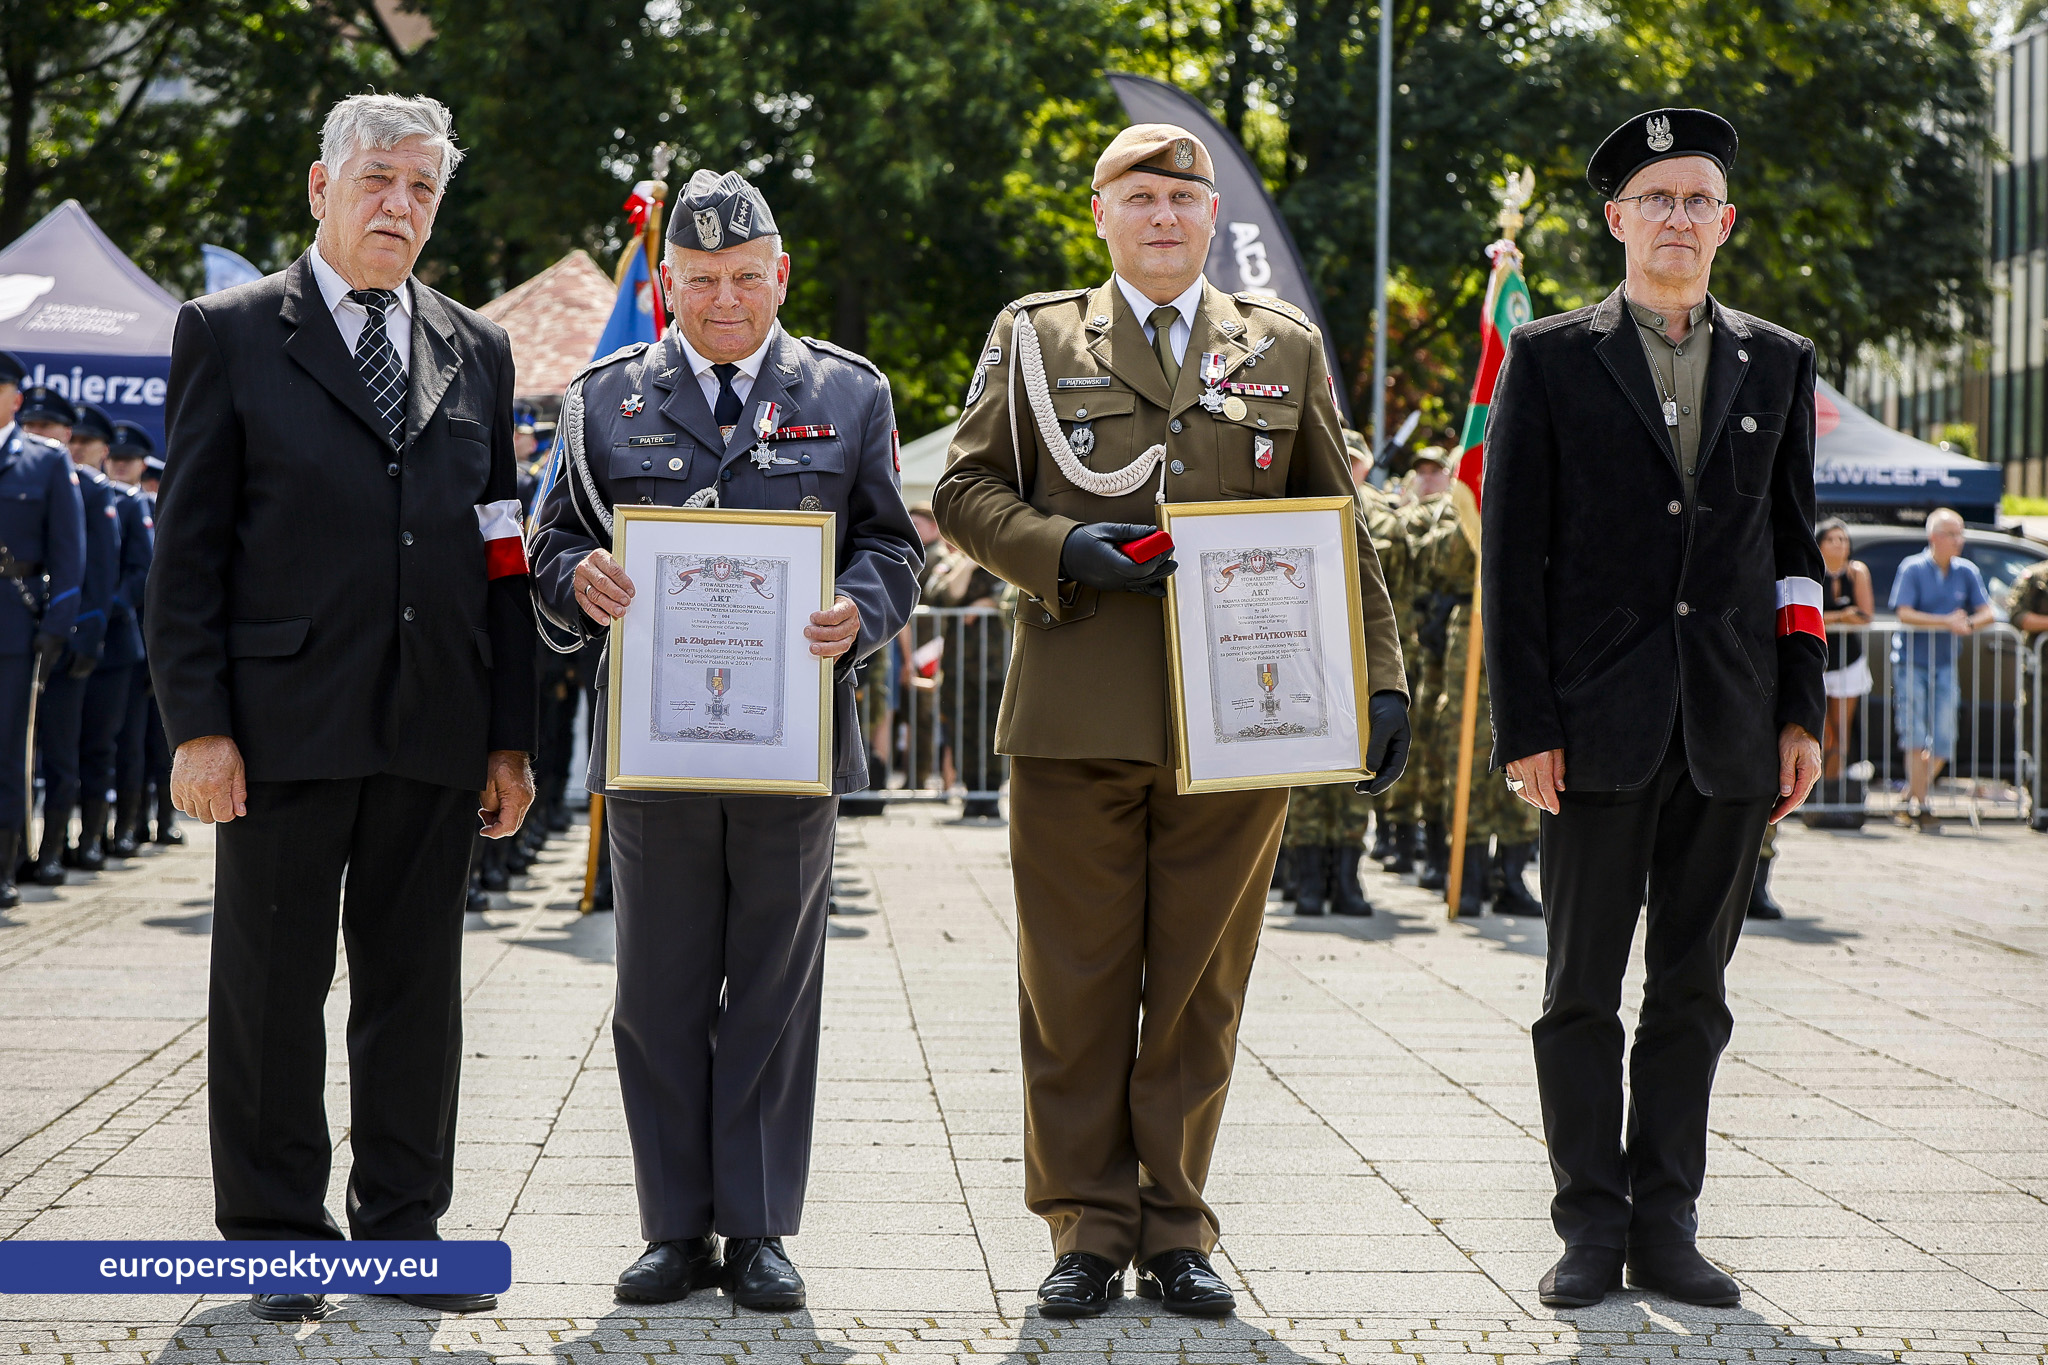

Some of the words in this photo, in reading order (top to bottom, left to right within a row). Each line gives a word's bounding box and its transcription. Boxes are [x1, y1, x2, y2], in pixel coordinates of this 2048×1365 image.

[1251, 589, 1270, 597] AKT
[674, 637, 688, 645] płk
[689, 637, 727, 646] Zbigniew
[728, 638, 764, 648] PIĄTEK
[1219, 634, 1232, 644] płk
[1232, 632, 1254, 642] Paweł
[1255, 630, 1307, 642] PIĄTKOWSKI
